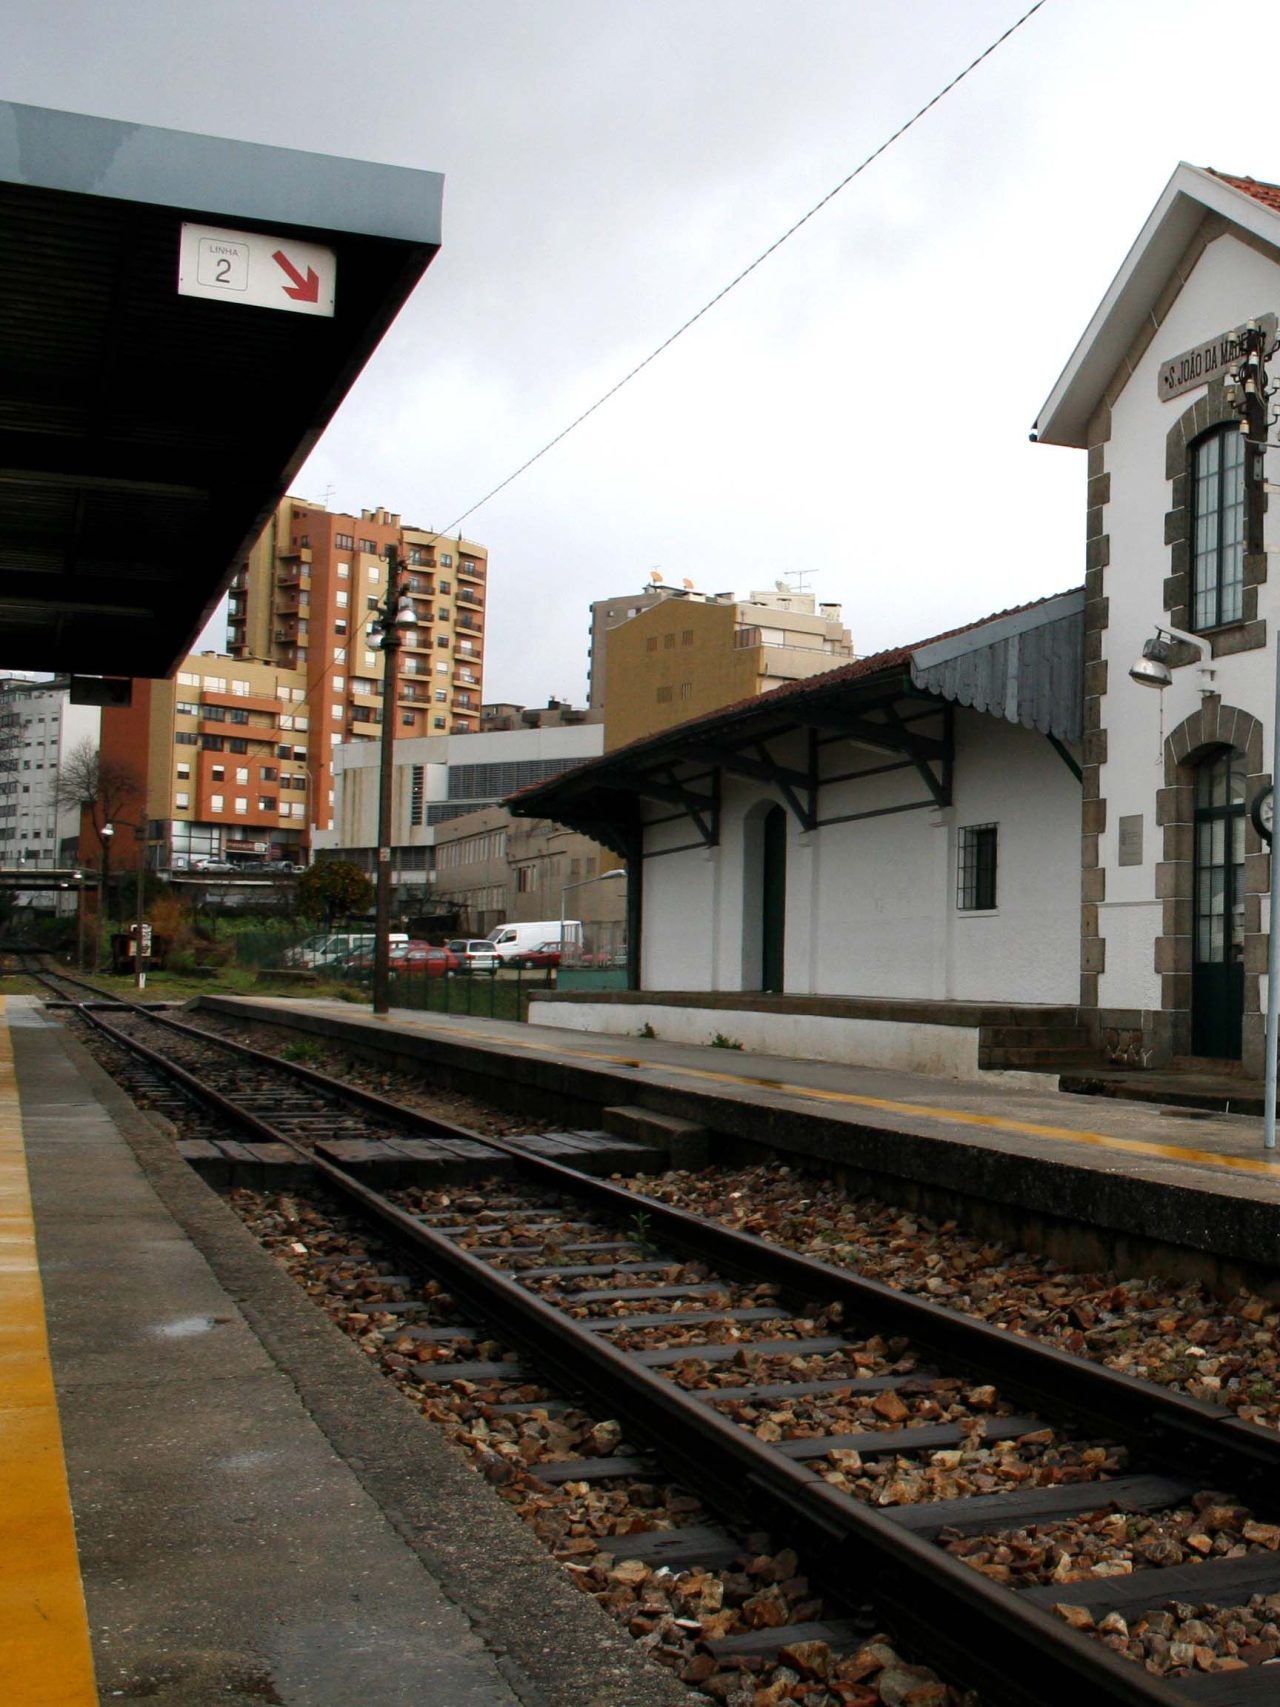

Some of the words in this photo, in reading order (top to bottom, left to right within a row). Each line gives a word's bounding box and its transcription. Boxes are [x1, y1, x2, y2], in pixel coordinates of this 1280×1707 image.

[209, 245, 239, 257] LINHA
[215, 258, 231, 284] 2
[1177, 350, 1202, 385] JOÃO
[1204, 345, 1218, 374] DA
